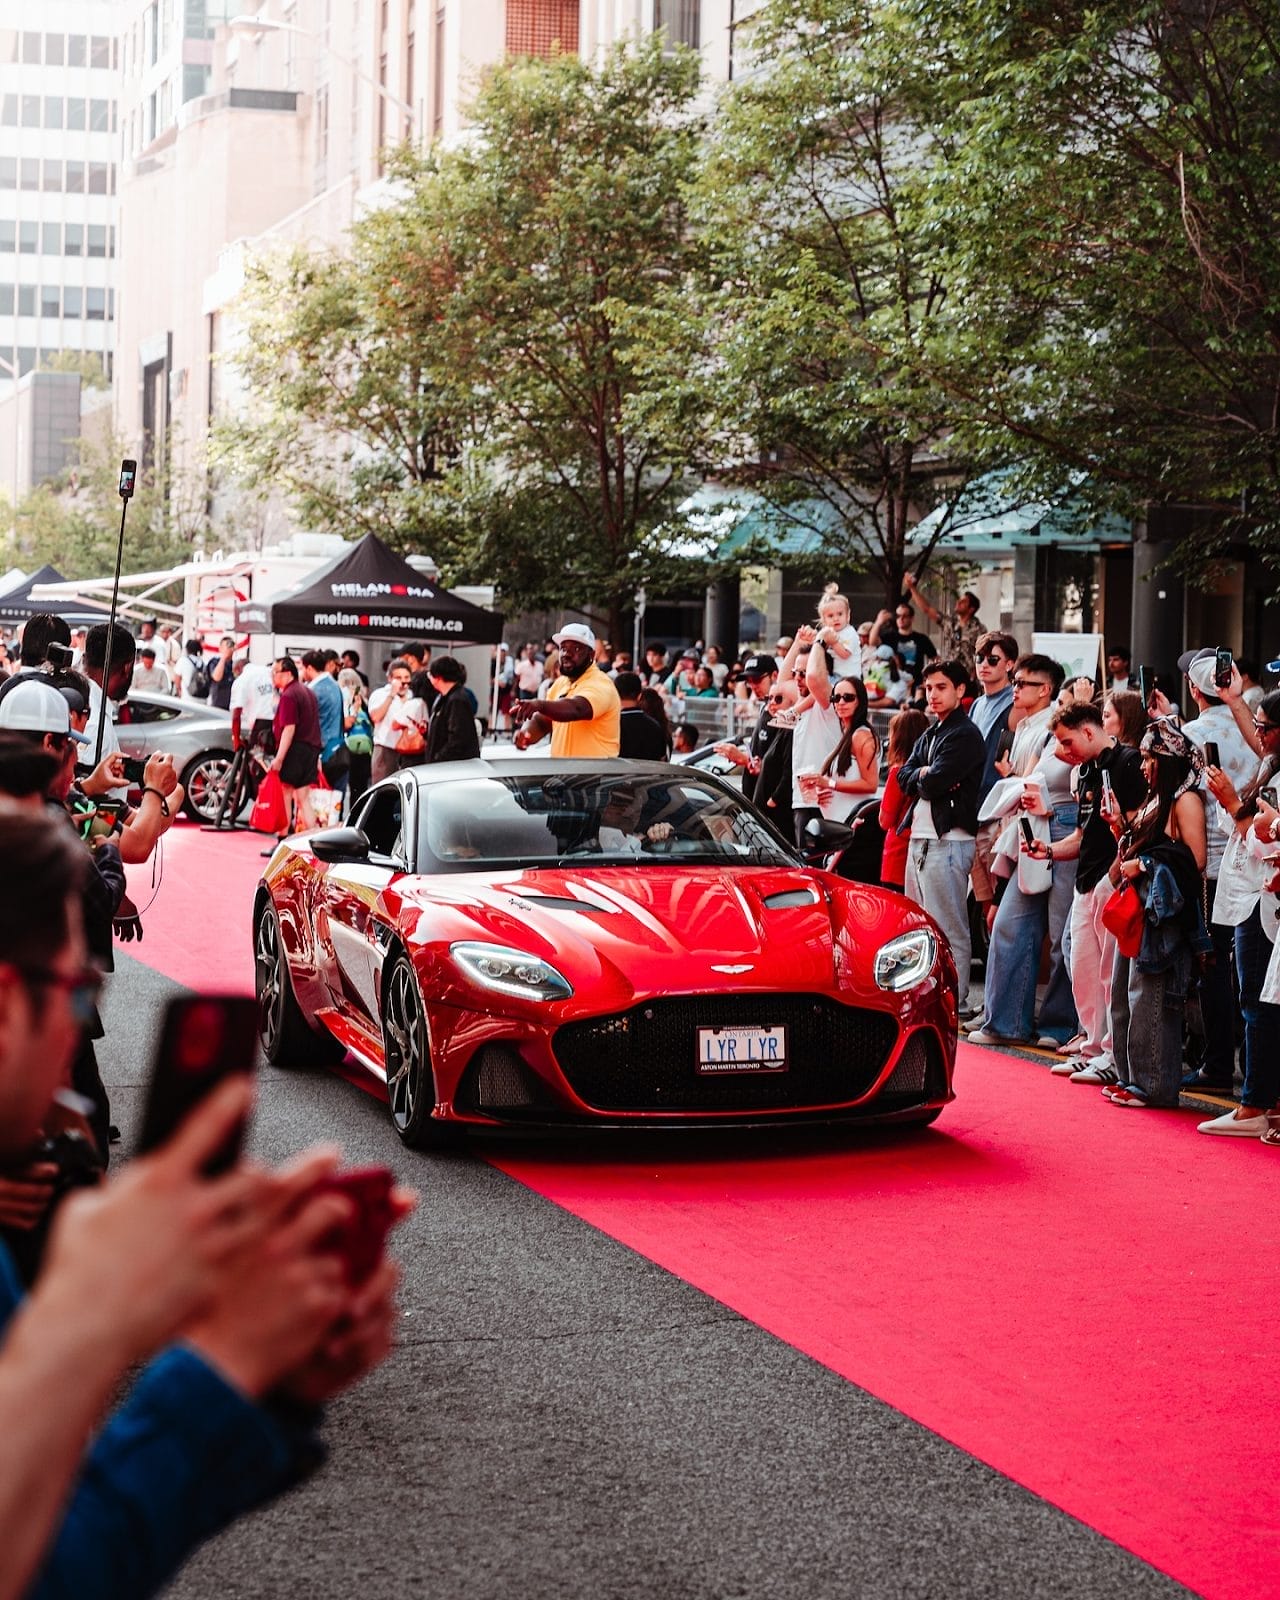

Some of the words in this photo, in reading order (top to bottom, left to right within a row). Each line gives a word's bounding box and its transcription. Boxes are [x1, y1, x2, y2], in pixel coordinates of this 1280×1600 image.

[314, 611, 463, 632] melanomacanada.ca
[707, 1039, 737, 1062] LYR
[748, 1037, 778, 1060] LYR
